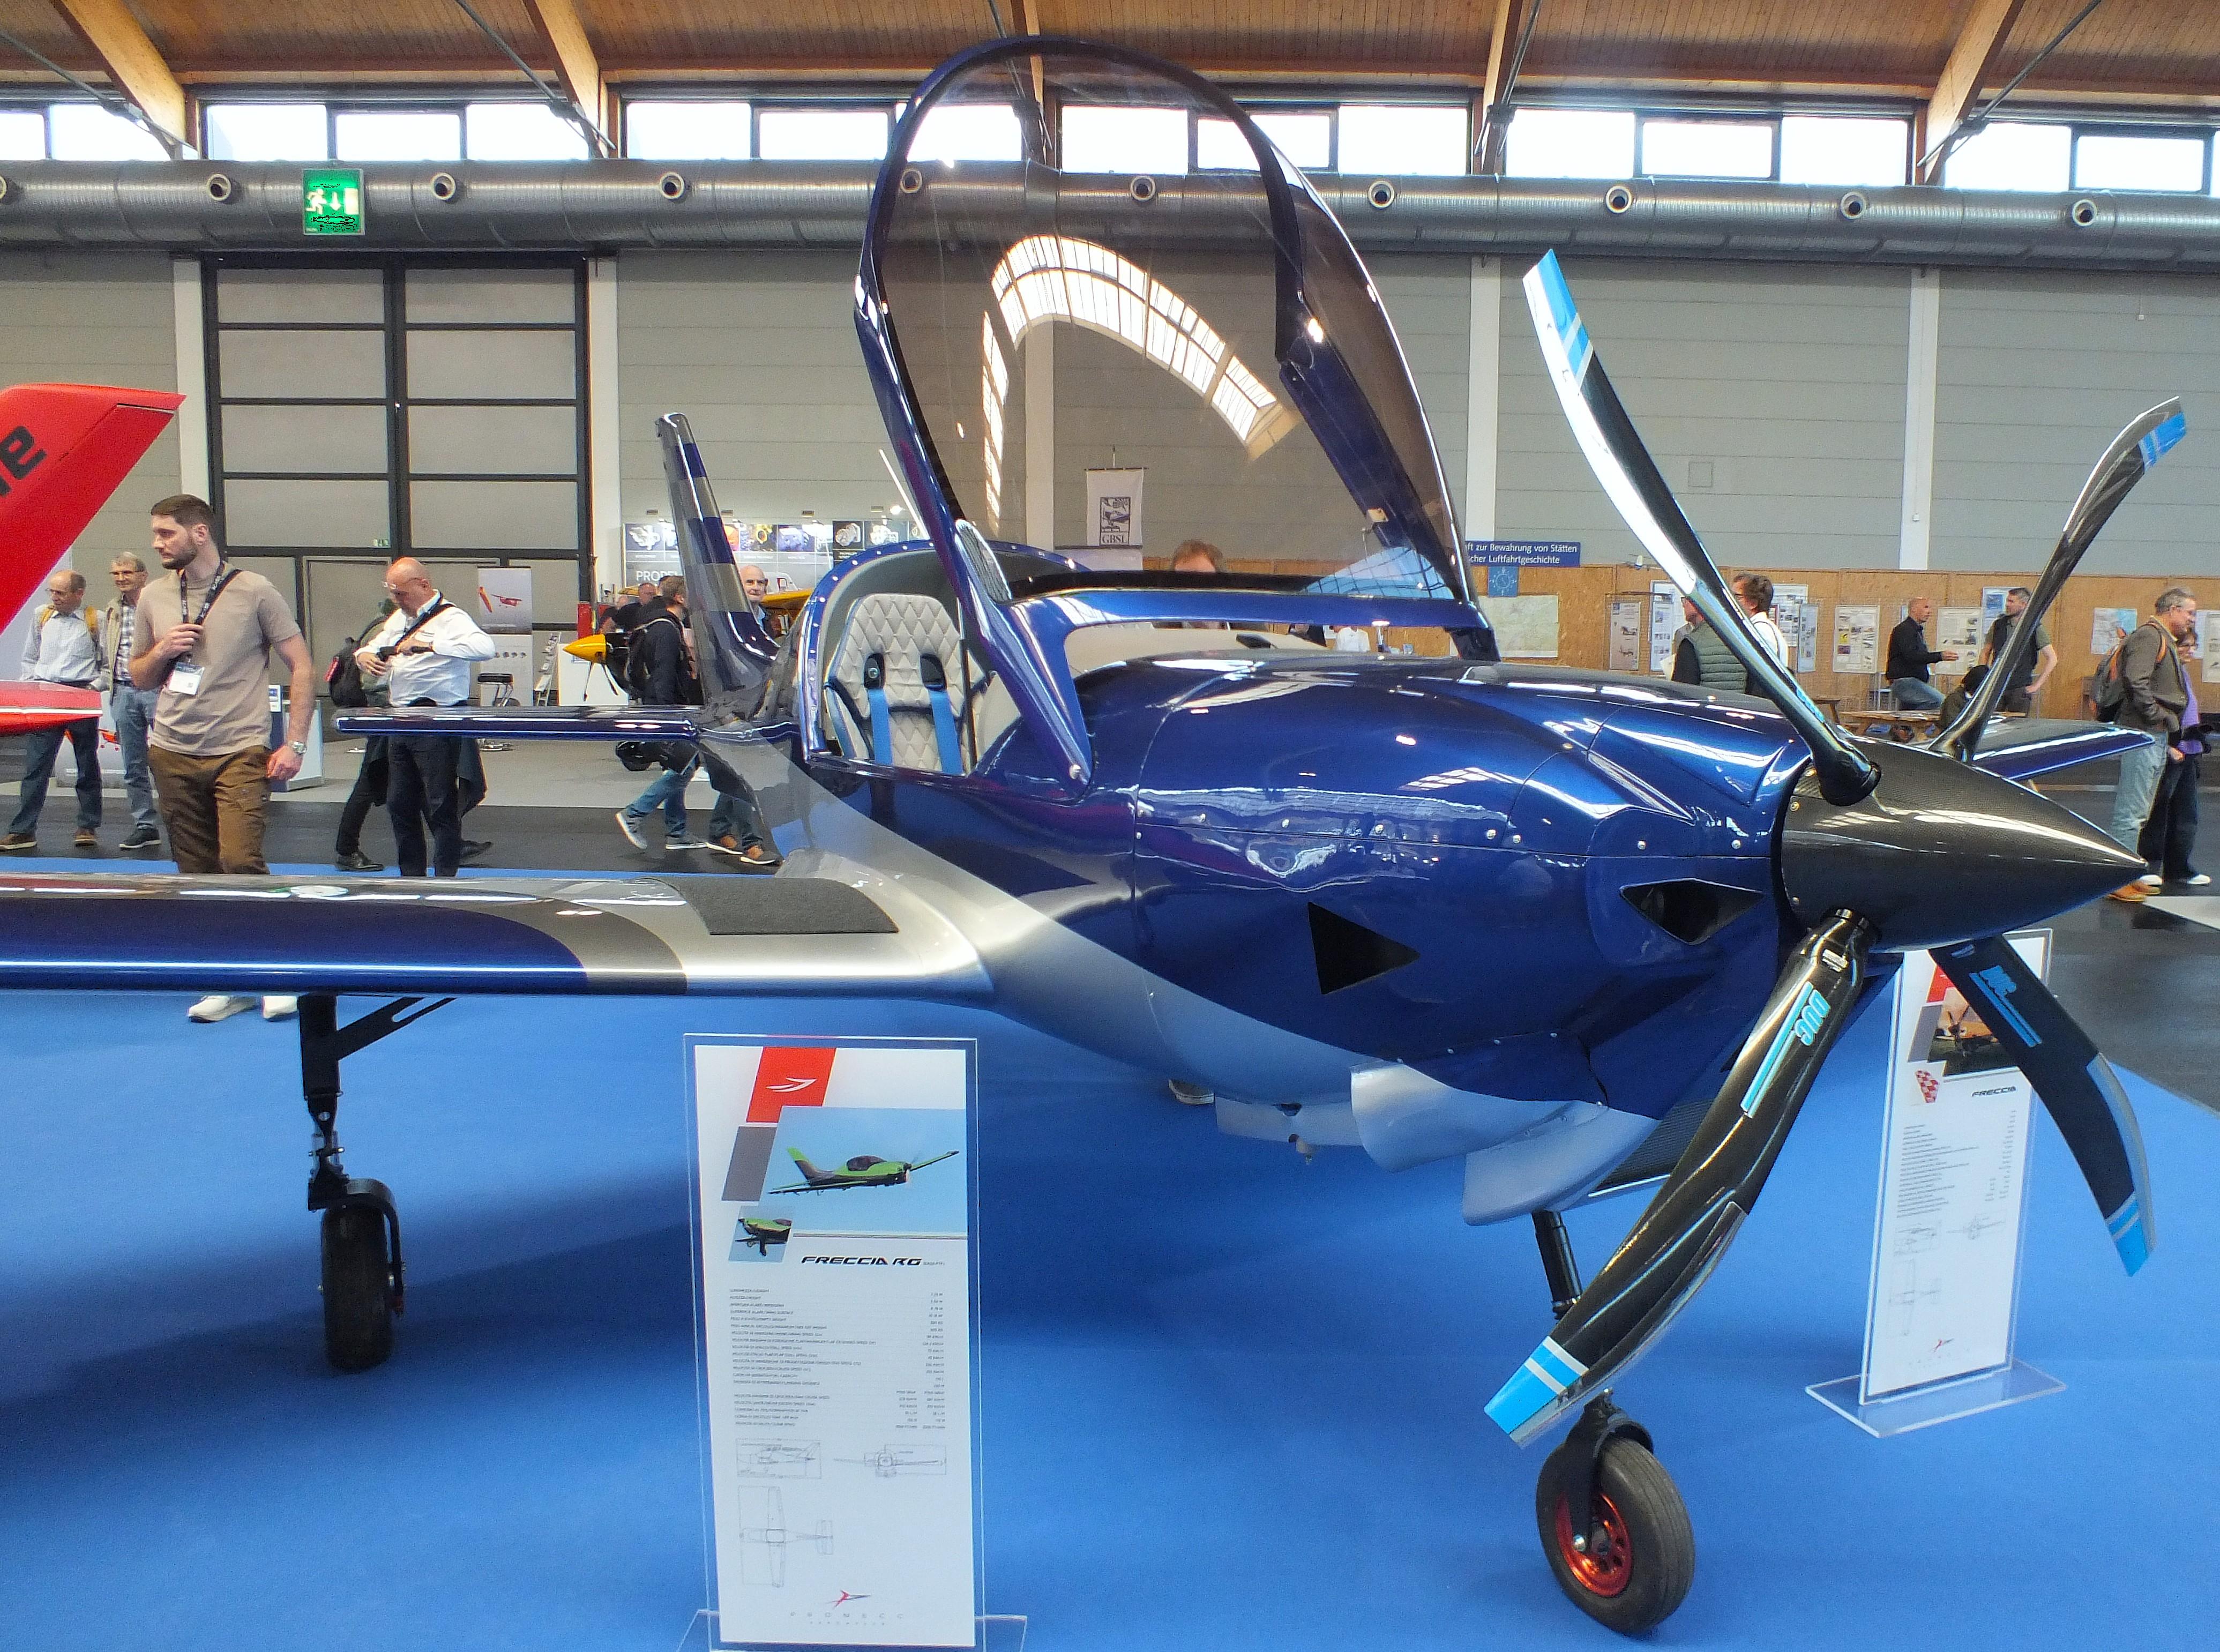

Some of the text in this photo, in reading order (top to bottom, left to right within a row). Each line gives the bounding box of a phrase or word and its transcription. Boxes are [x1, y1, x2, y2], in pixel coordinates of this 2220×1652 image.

[1102, 534, 1128, 543] GBSL
[1490, 543, 1532, 554] Bewahrung
[1550, 544, 1577, 553] Stätten
[1489, 555, 1560, 565] Luftfahrtgeschichte
[1972, 1086, 2016, 1097] FRECCIA
[801, 1255, 888, 1265] FRECCIA
[892, 1257, 922, 1266] RG
